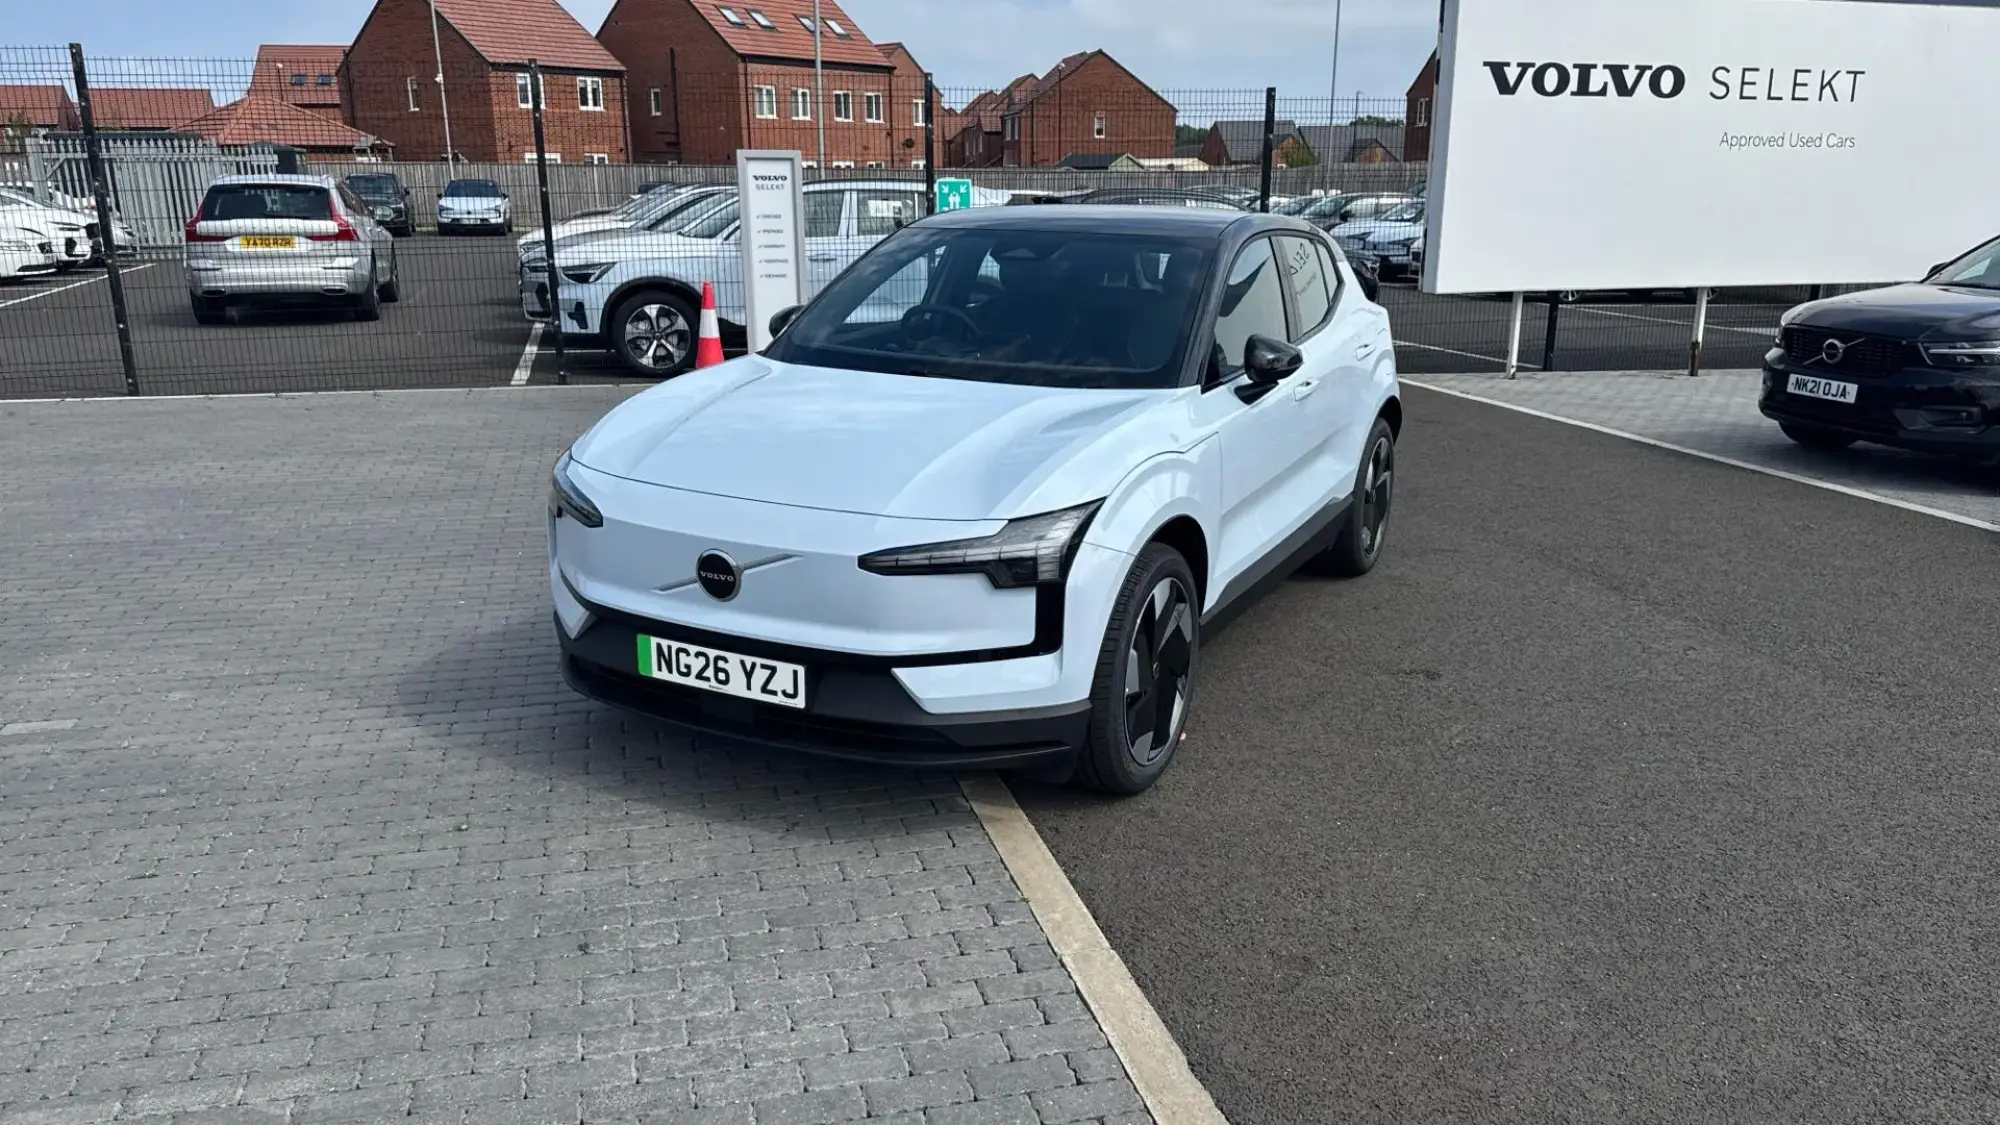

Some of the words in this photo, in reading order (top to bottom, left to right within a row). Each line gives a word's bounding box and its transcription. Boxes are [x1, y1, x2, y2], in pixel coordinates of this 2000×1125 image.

[1483, 61, 1685, 98] VOLVO
[1710, 66, 1866, 102] SELEKT
[1719, 131, 1785, 150] Approved
[1789, 132, 1823, 148] Used
[1826, 133, 1855, 148] Cars
[1794, 377, 1821, 394] NK21
[1823, 382, 1847, 399] OJA
[700, 571, 734, 581] VOLVO
[656, 642, 730, 686] NG26
[739, 659, 799, 699] YZJ
